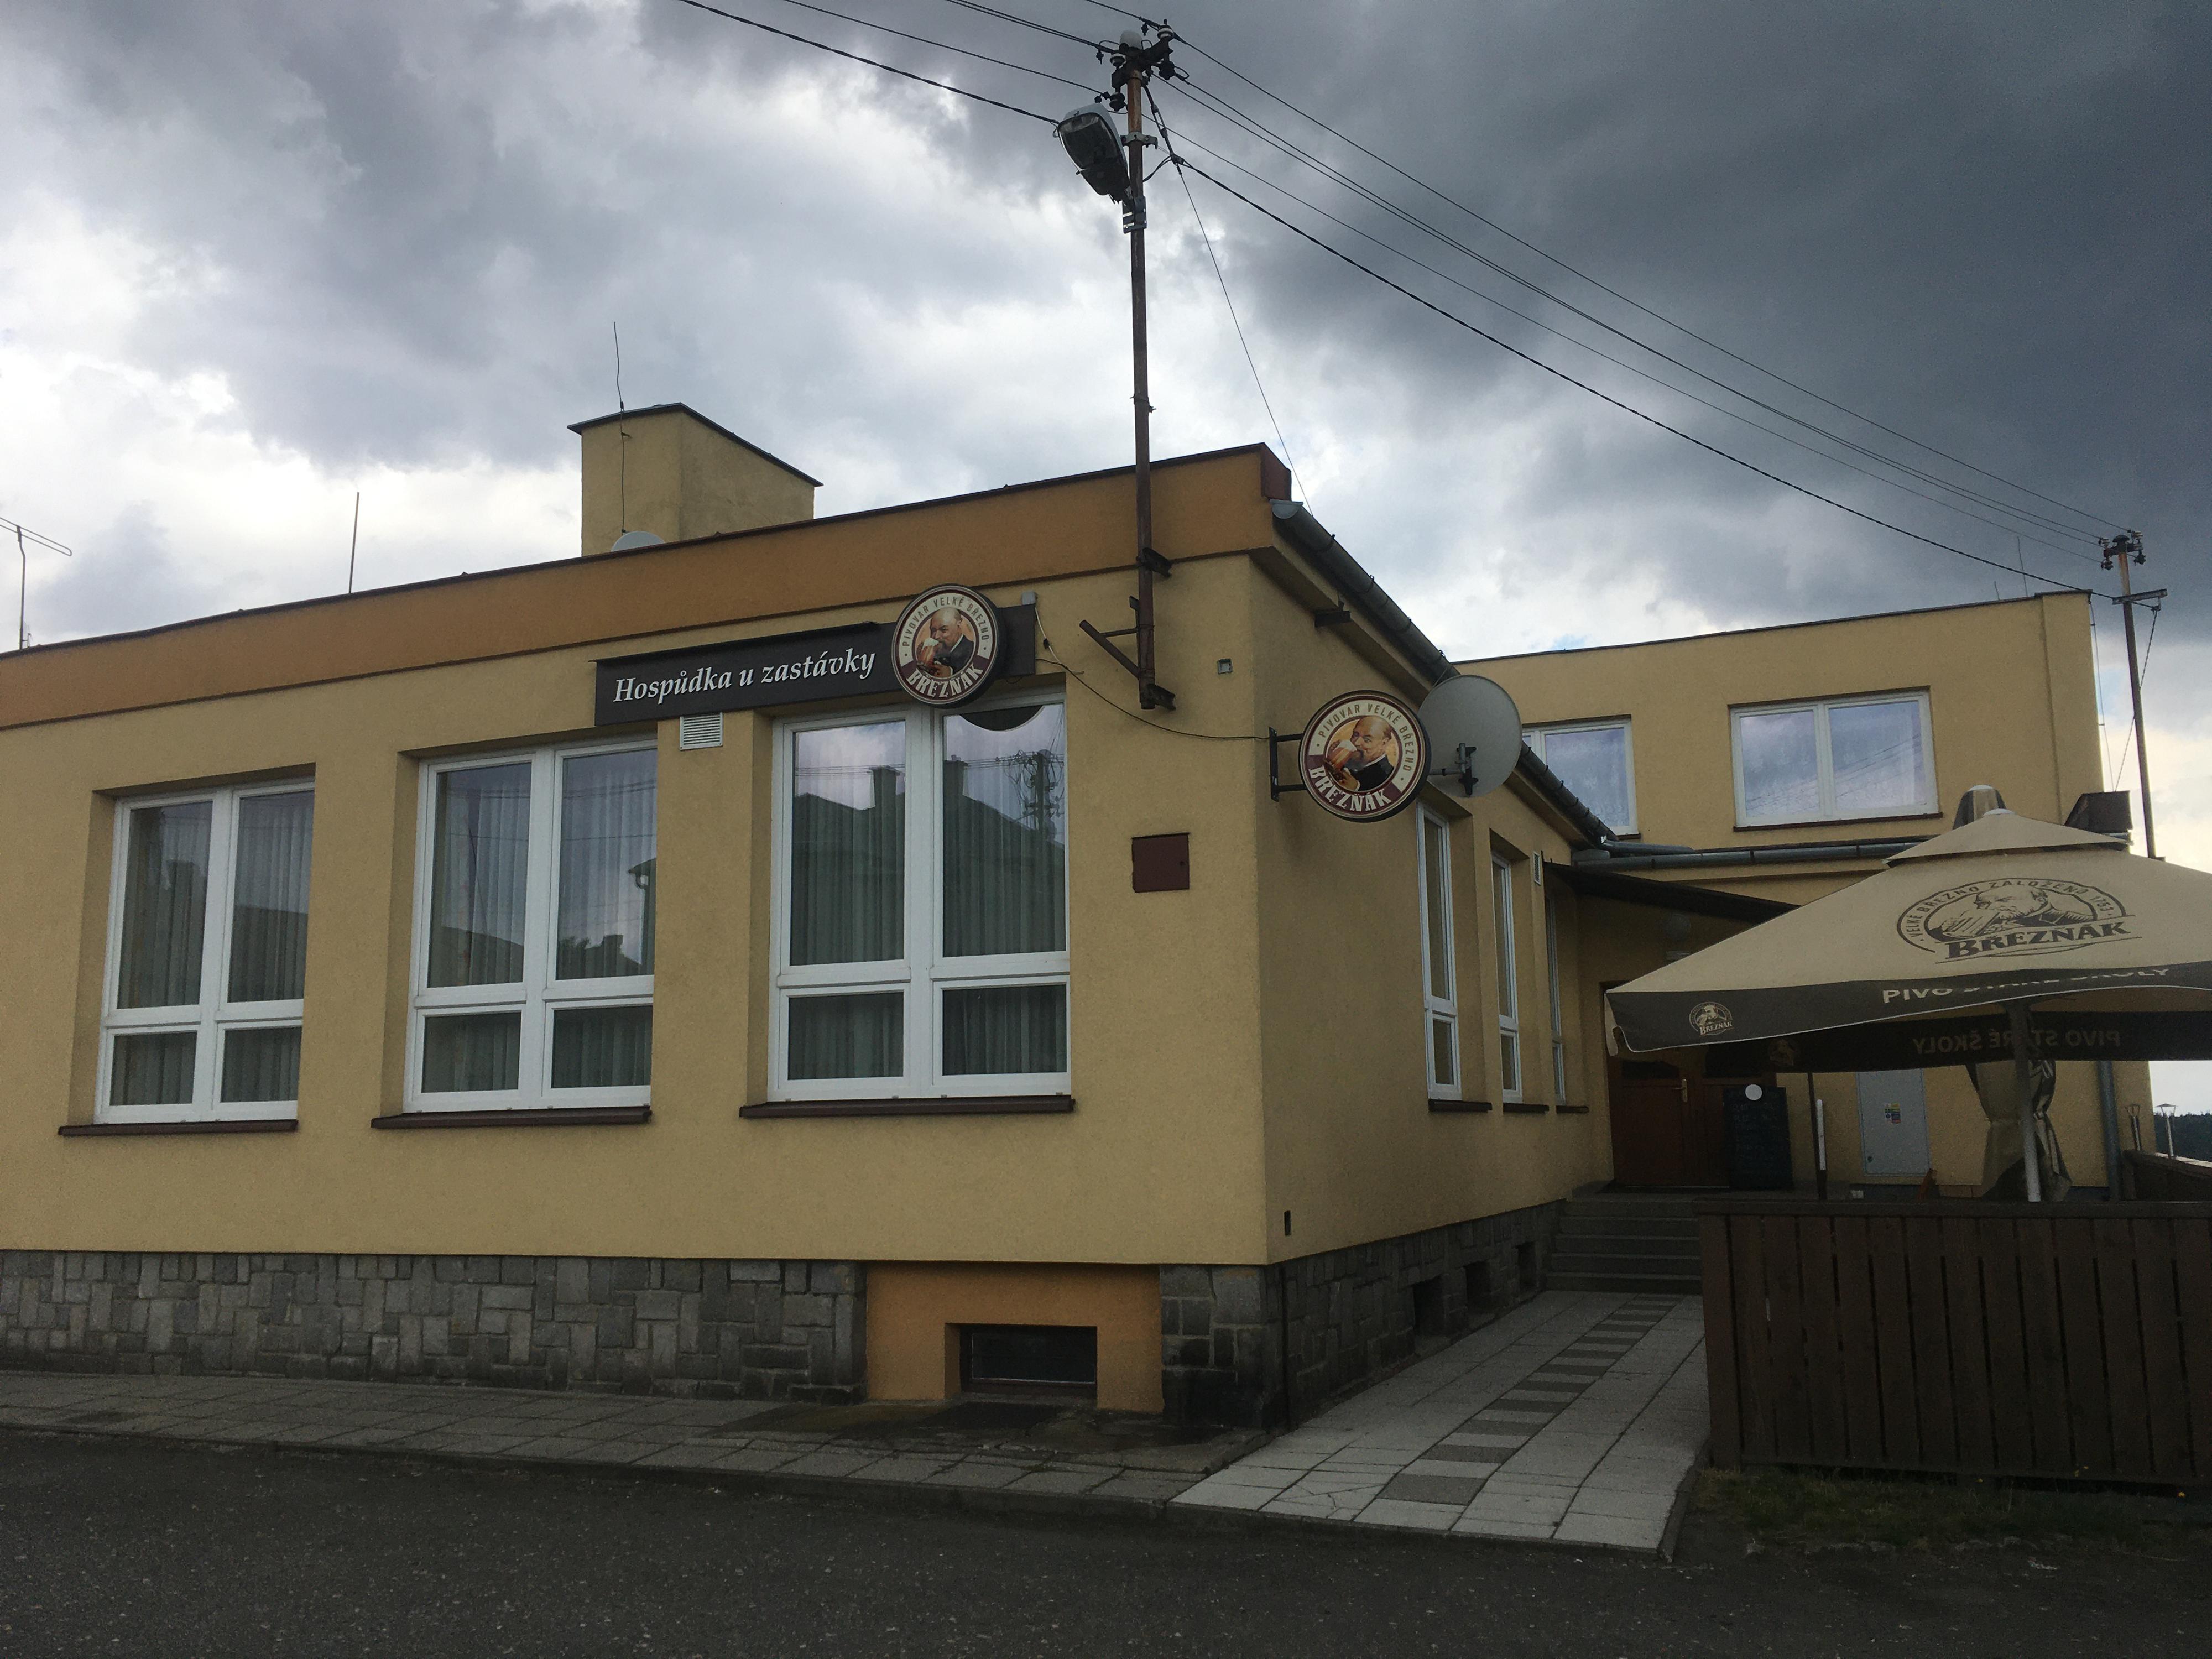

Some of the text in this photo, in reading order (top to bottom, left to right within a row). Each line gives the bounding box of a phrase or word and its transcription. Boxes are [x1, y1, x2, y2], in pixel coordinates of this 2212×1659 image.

[902, 596, 990, 647] PIVOVAR VELKÉ BŘEZNO
[613, 648, 876, 705] Hospůdka u zastávky
[906, 662, 984, 698] BŘEZŇÁK
[1318, 703, 1415, 773] PIVOVAR VELKÉ BŘEZNO
[1308, 765, 1392, 812] BŘEZŇÁK
[1906, 915, 1923, 938] VELKÉ
[1989, 880, 2089, 894] ZALOŽENO
[1882, 988, 1953, 1004] PIVO
